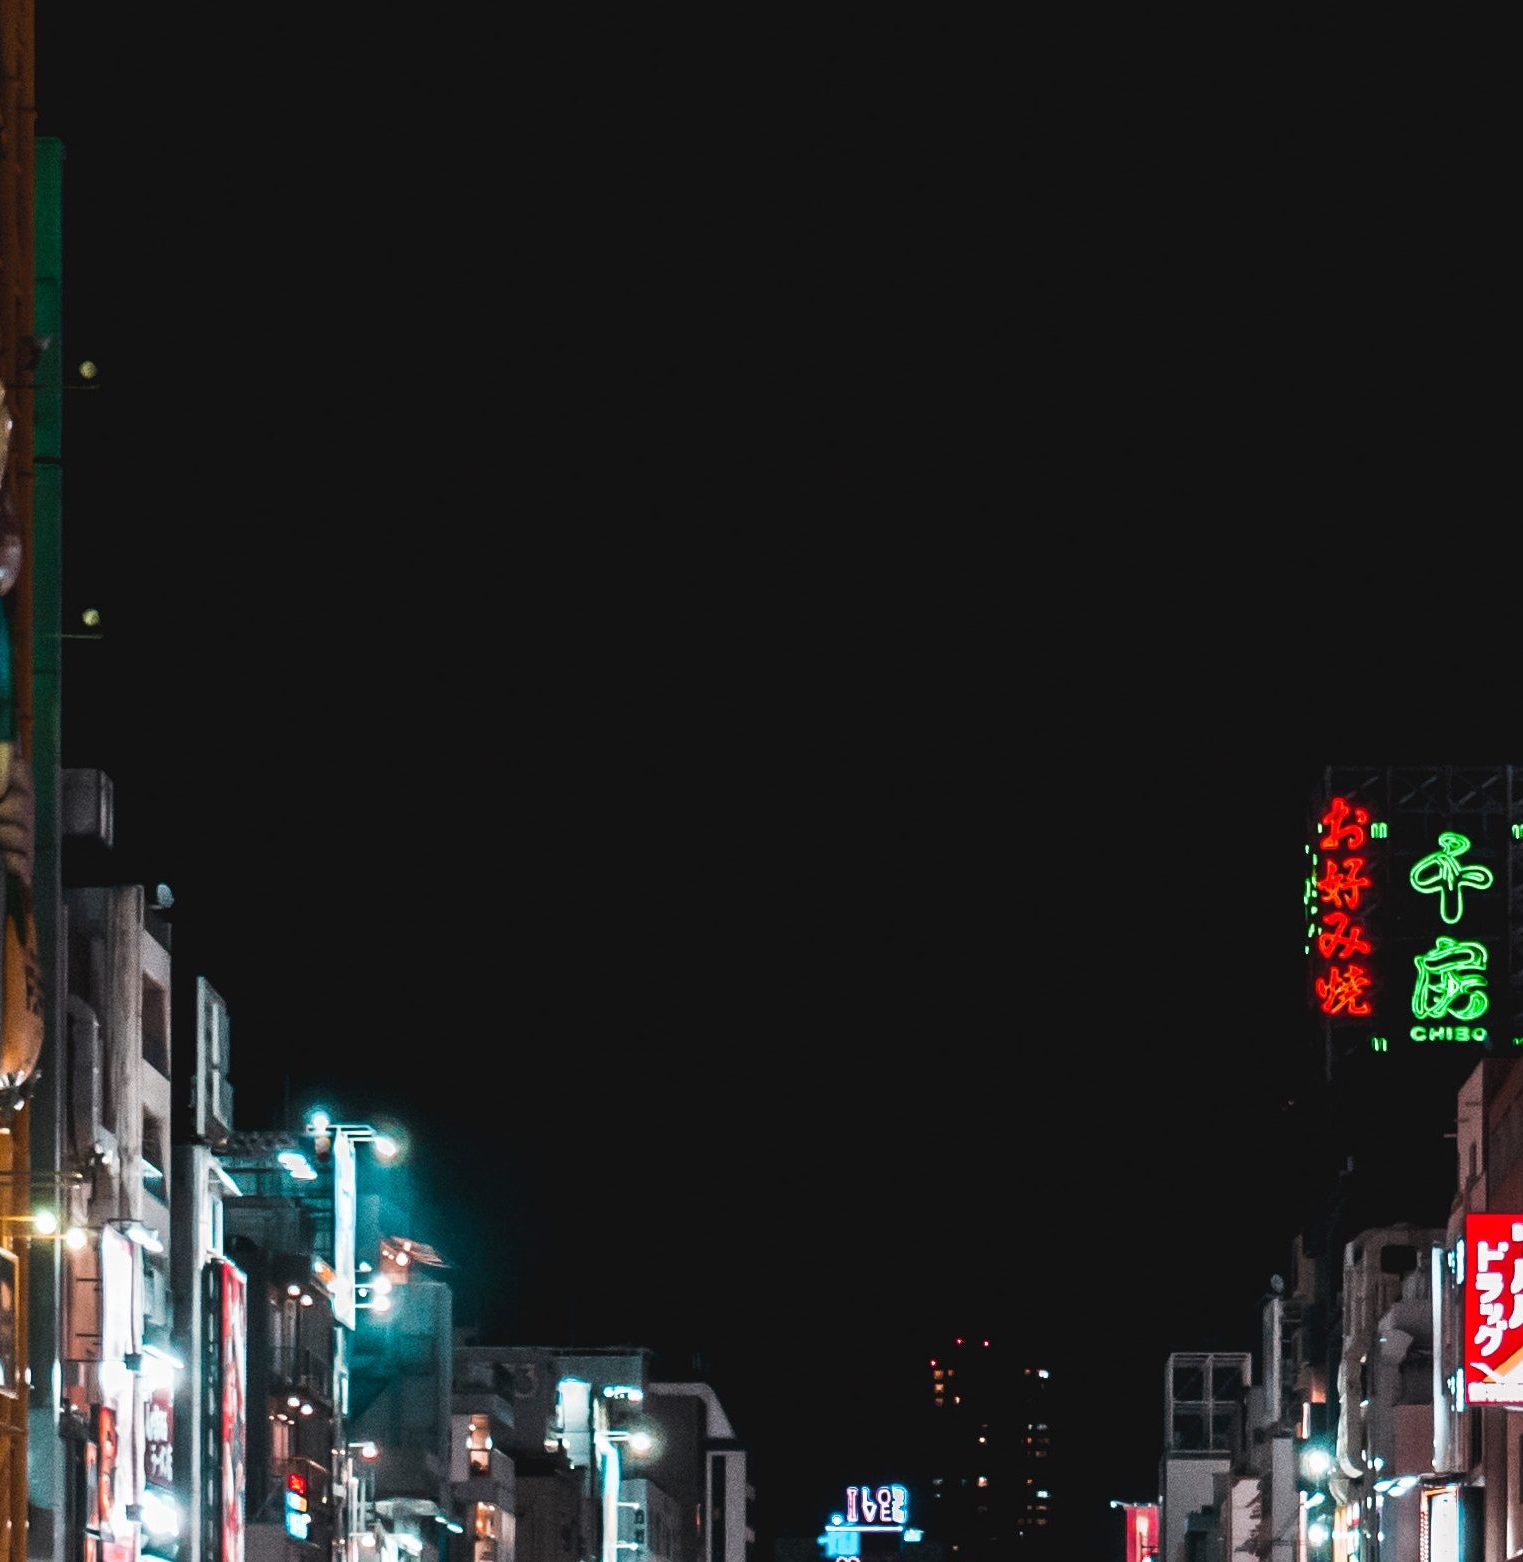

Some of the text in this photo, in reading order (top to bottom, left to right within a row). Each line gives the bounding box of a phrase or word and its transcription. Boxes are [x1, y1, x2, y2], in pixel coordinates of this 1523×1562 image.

[1316, 797, 1372, 1017] お好み焼
[1409, 832, 1494, 1020] 千房
[1409, 1026, 1488, 1043] CHIBO
[1474, 1240, 1510, 1357] ドラッグ
